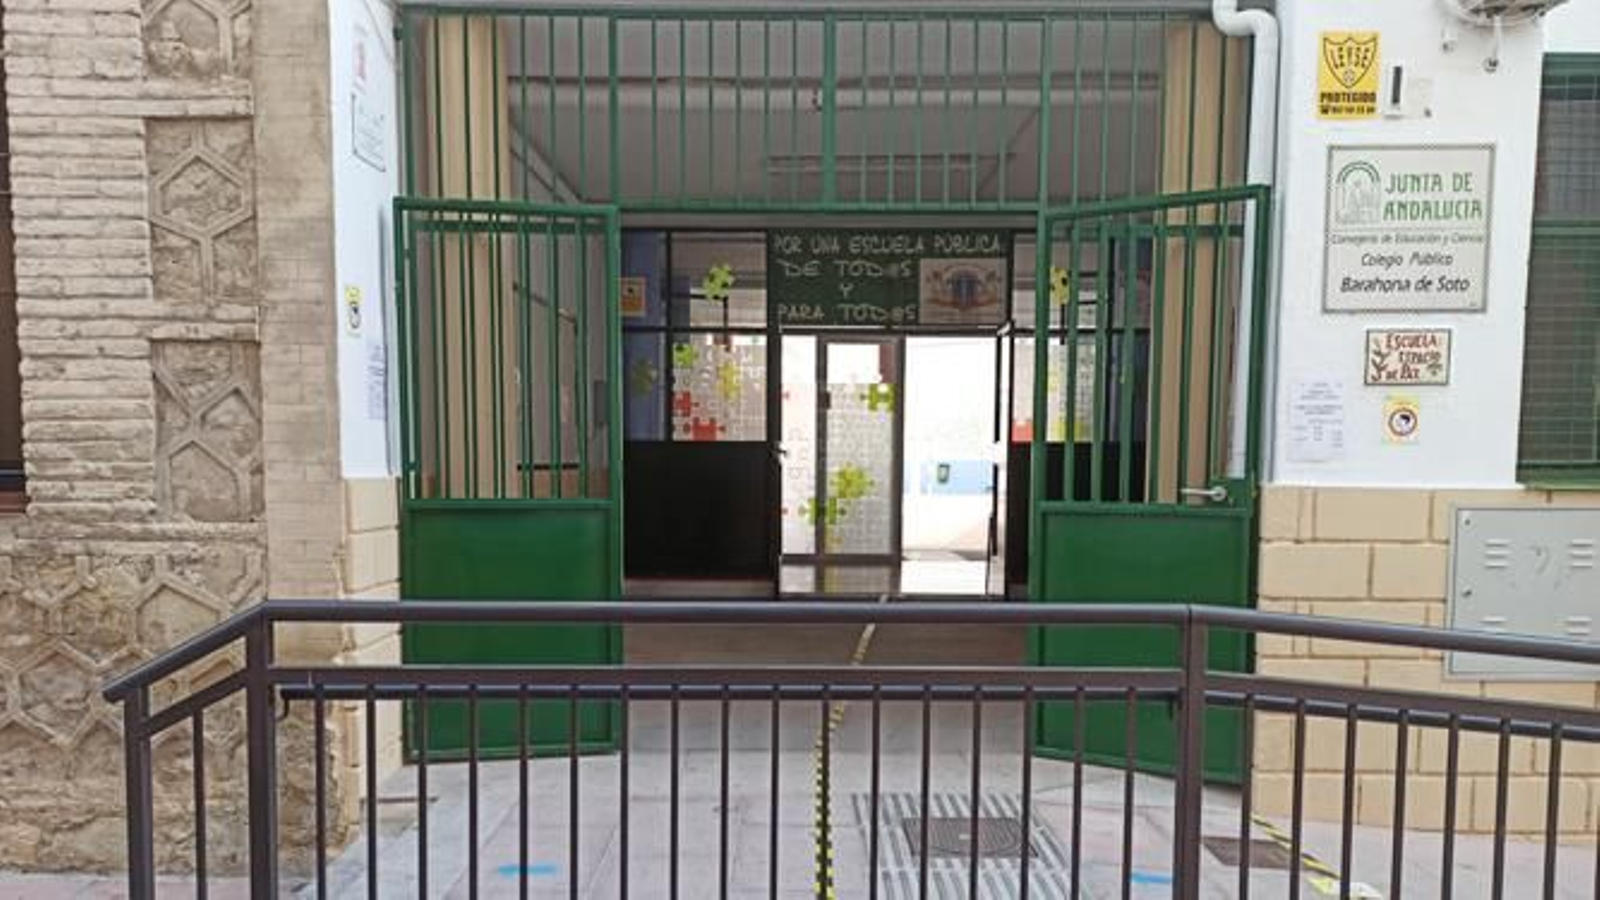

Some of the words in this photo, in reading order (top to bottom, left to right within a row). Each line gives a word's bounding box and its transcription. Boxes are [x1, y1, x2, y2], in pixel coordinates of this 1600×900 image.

[1320, 91, 1376, 103] PROTEGIDO
[1385, 172, 1443, 194] JUNTA
[1452, 172, 1473, 192] DE
[774, 233, 801, 253] POR
[810, 233, 840, 253] UNA
[849, 234, 923, 253] ESCUELA
[1381, 233, 1393, 243] de
[775, 258, 821, 276] DE
[1361, 253, 1403, 270] Colegio
[839, 281, 854, 298] Y
[1340, 277, 1410, 292] Barahona
[1414, 276, 1433, 291] de
[1436, 275, 1470, 291] Soto
[778, 303, 825, 320] PARA
[1386, 333, 1437, 350] ESCUELA
